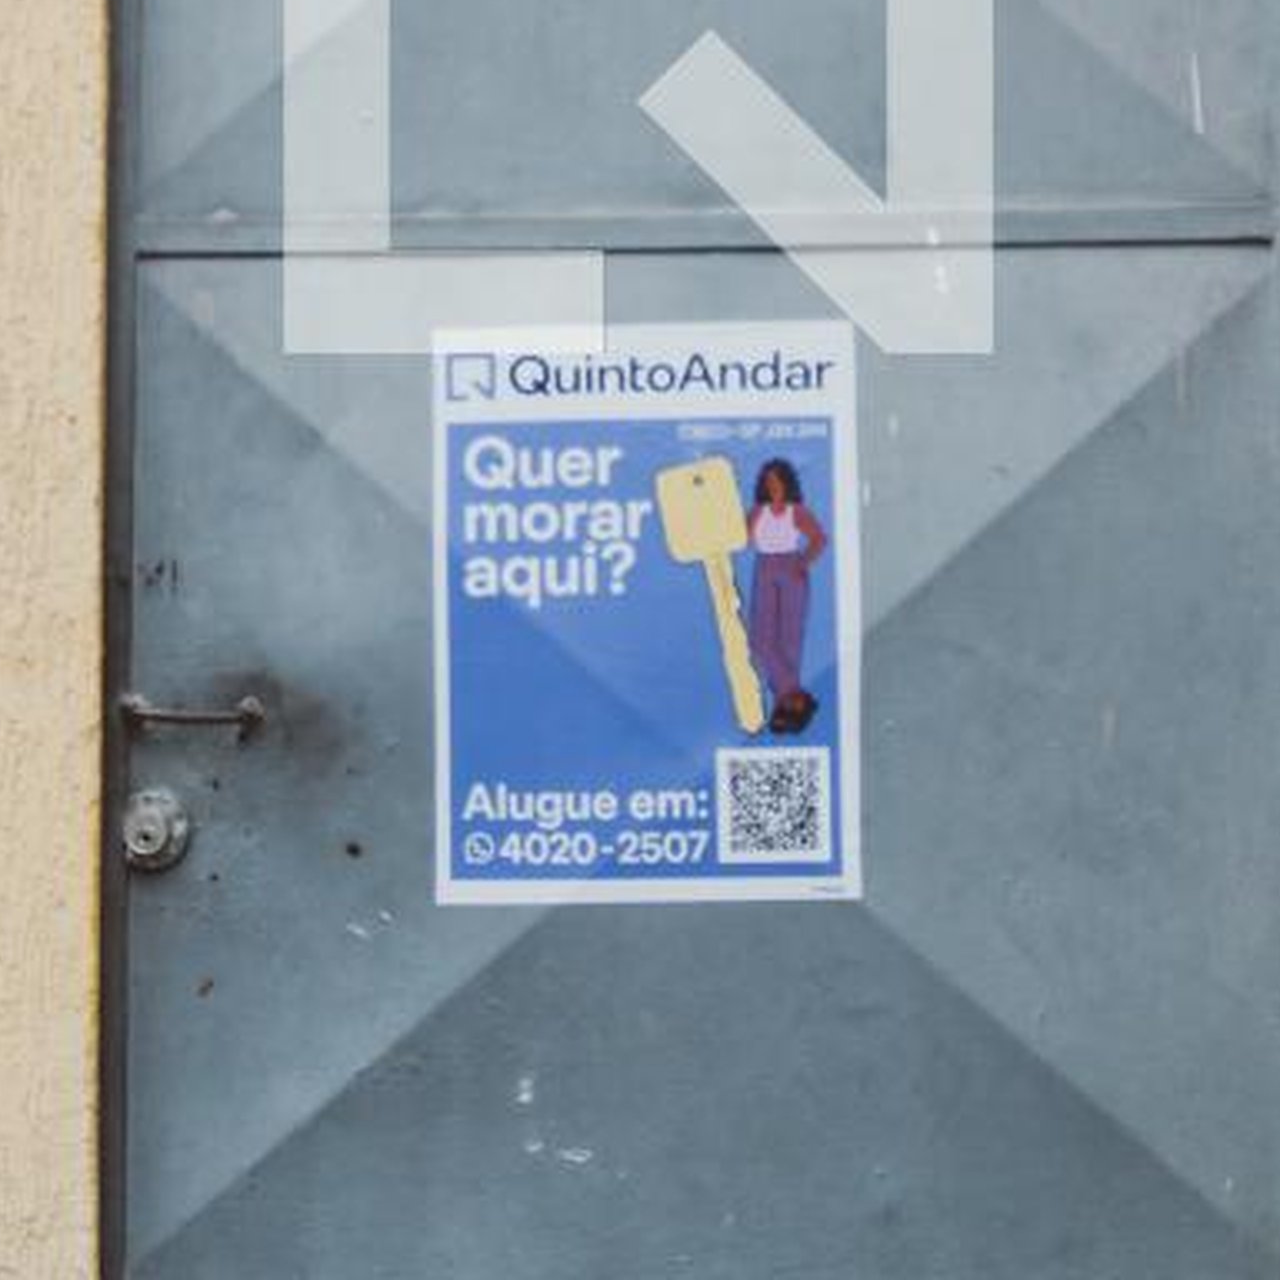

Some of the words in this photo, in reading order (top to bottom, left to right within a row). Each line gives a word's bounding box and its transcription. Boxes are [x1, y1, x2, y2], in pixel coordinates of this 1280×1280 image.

[508, 351, 835, 396] QuintoAndar
[463, 435, 623, 490] Quer
[463, 497, 651, 542] morar
[462, 542, 637, 608] aqui?
[462, 782, 618, 828] Alugue
[629, 786, 710, 819] em:
[499, 830, 710, 864] 4020-2507
